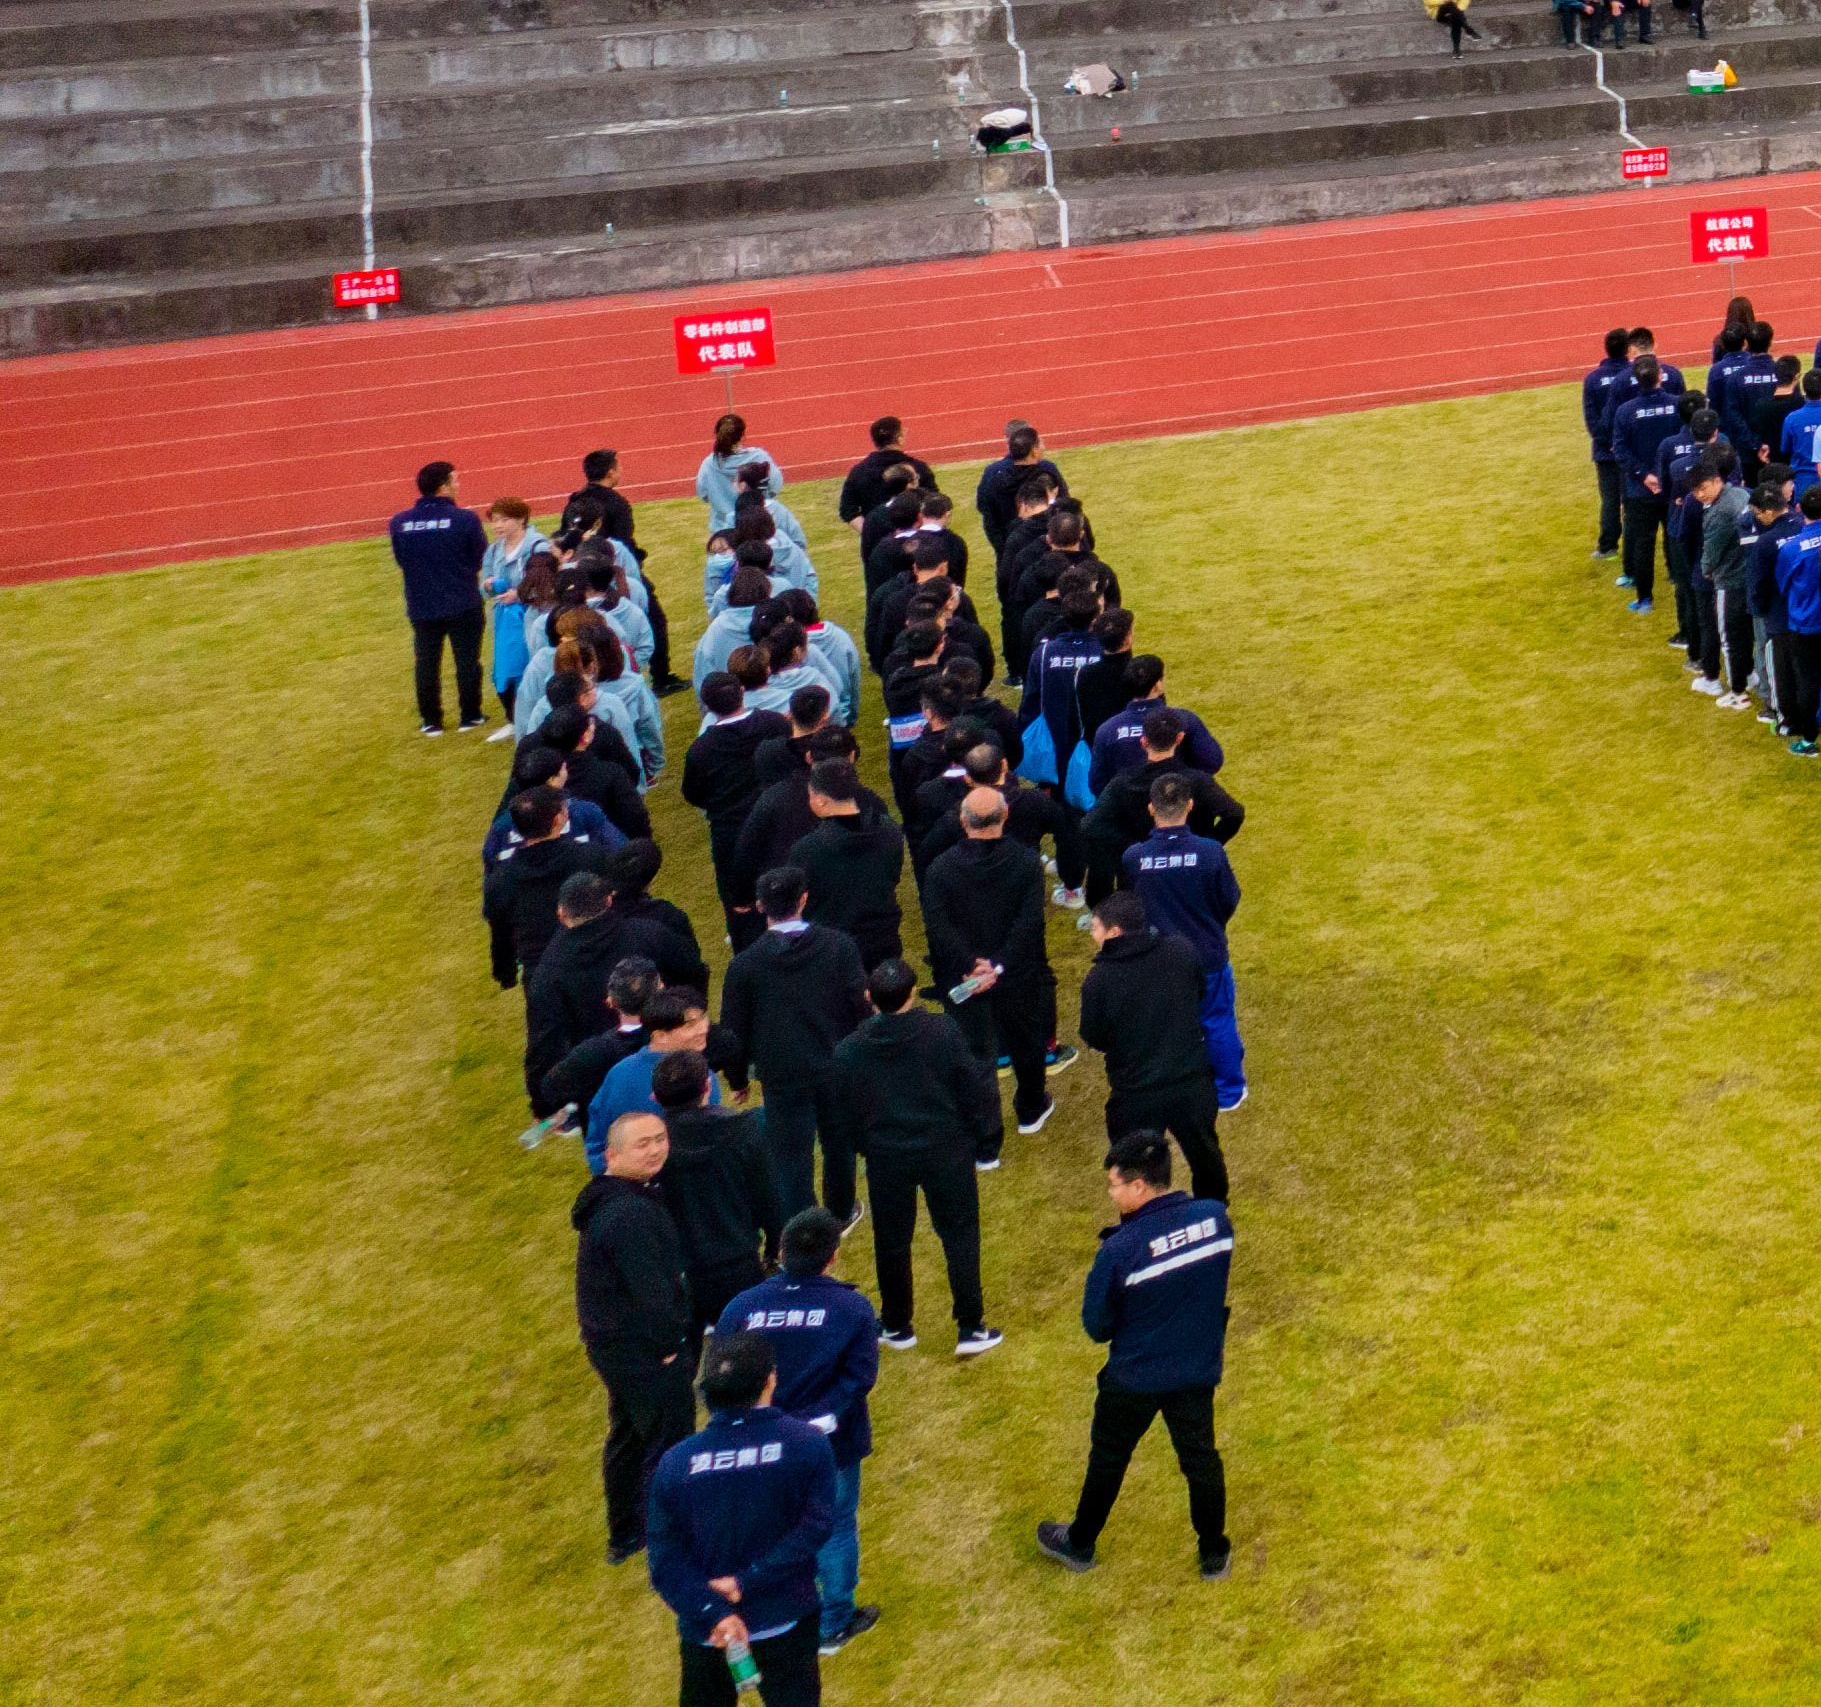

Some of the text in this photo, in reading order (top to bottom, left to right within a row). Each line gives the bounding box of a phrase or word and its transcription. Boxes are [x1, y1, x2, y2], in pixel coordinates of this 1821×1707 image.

[1708, 235, 1755, 253] 代表队
[698, 341, 756, 363] 代表队
[1139, 853, 1197, 871] 凌云集团
[1150, 1217, 1219, 1259] 凌云集团
[747, 1307, 826, 1331] 凌云集团
[690, 1441, 783, 1475] 凌云集团
